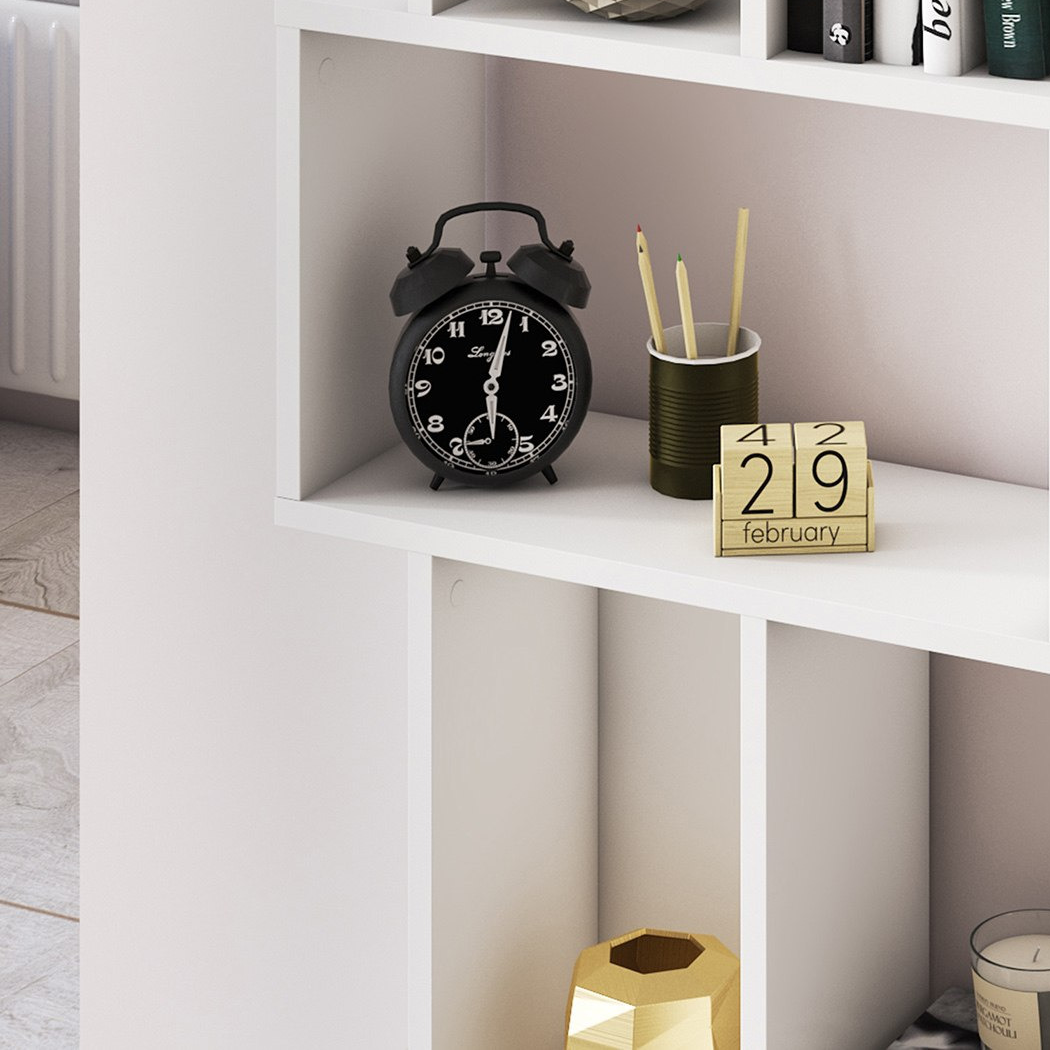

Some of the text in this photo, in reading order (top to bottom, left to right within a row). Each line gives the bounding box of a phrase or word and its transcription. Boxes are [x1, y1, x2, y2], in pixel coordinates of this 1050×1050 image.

[1002, 14, 1021, 48] Brown
[478, 309, 504, 326] 12
[519, 316, 529, 333] 1
[447, 321, 465, 338] 11
[422, 346, 445, 365] 10
[541, 340, 558, 357] 2
[414, 379, 432, 398] 9
[551, 374, 568, 391] 3
[540, 404, 558, 423] 4
[427, 414, 444, 433] 8
[518, 435, 535, 453] 5
[743, 521, 840, 546] february
